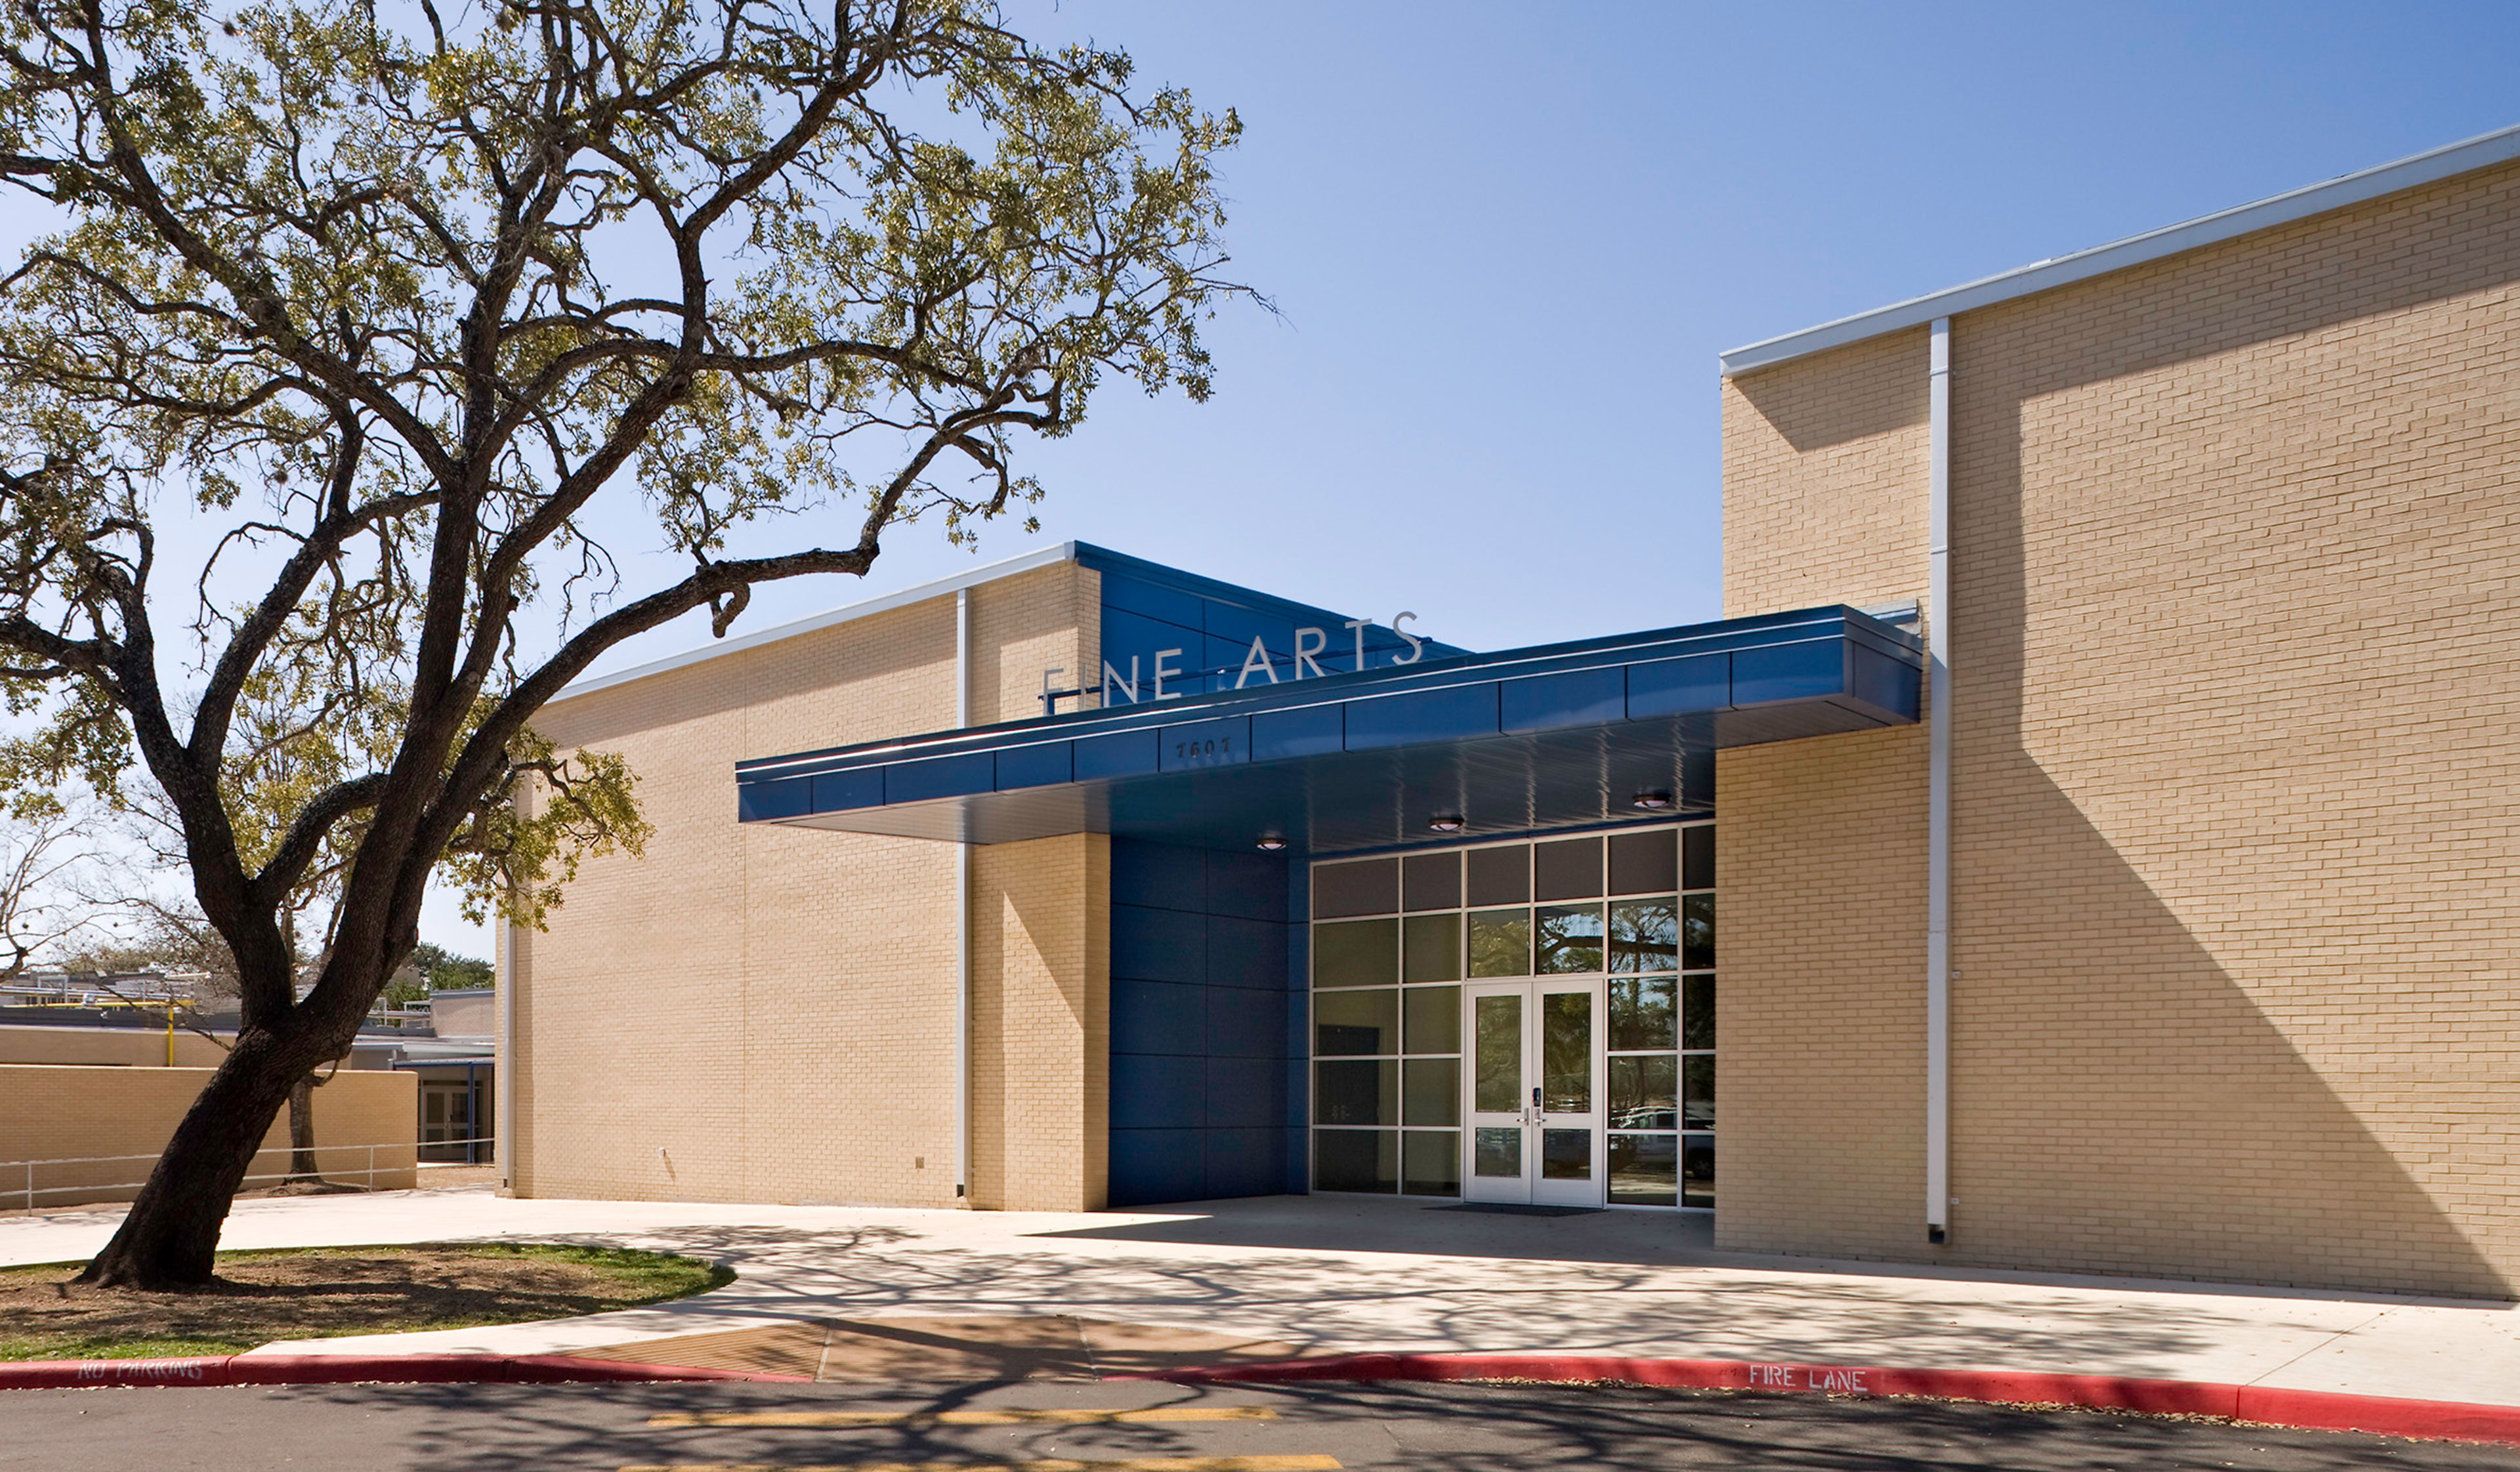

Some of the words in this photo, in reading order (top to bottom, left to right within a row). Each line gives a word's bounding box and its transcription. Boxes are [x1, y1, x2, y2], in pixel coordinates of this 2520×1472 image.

[1043, 647, 1183, 716] FINE
[1234, 611, 1423, 688] ARTS
[78, 1362, 106, 1379] NO
[116, 1360, 202, 1379] PARKING
[1750, 1364, 1796, 1387] FIRE
[1809, 1370, 1868, 1392] LANE
